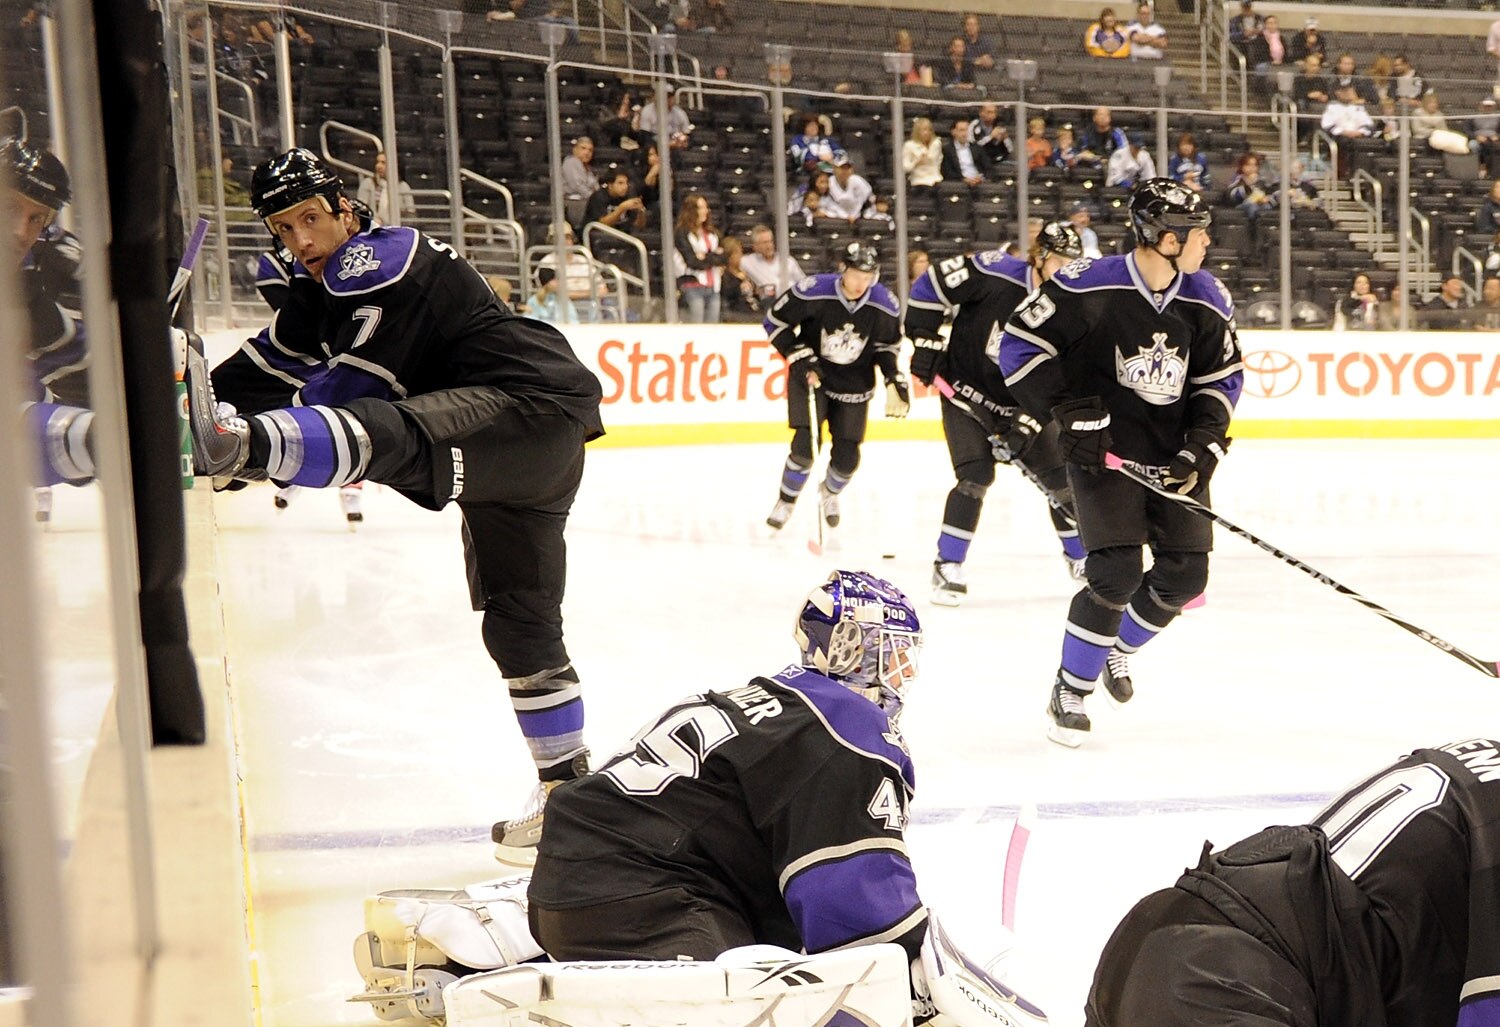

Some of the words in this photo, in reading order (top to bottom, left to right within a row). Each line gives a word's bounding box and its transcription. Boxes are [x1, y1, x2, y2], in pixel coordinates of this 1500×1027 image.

[940, 255, 969, 289] 26
[351, 305, 383, 349] 7
[1014, 288, 1057, 329] 3
[597, 340, 728, 404] State
[594, 694, 740, 796] 5
